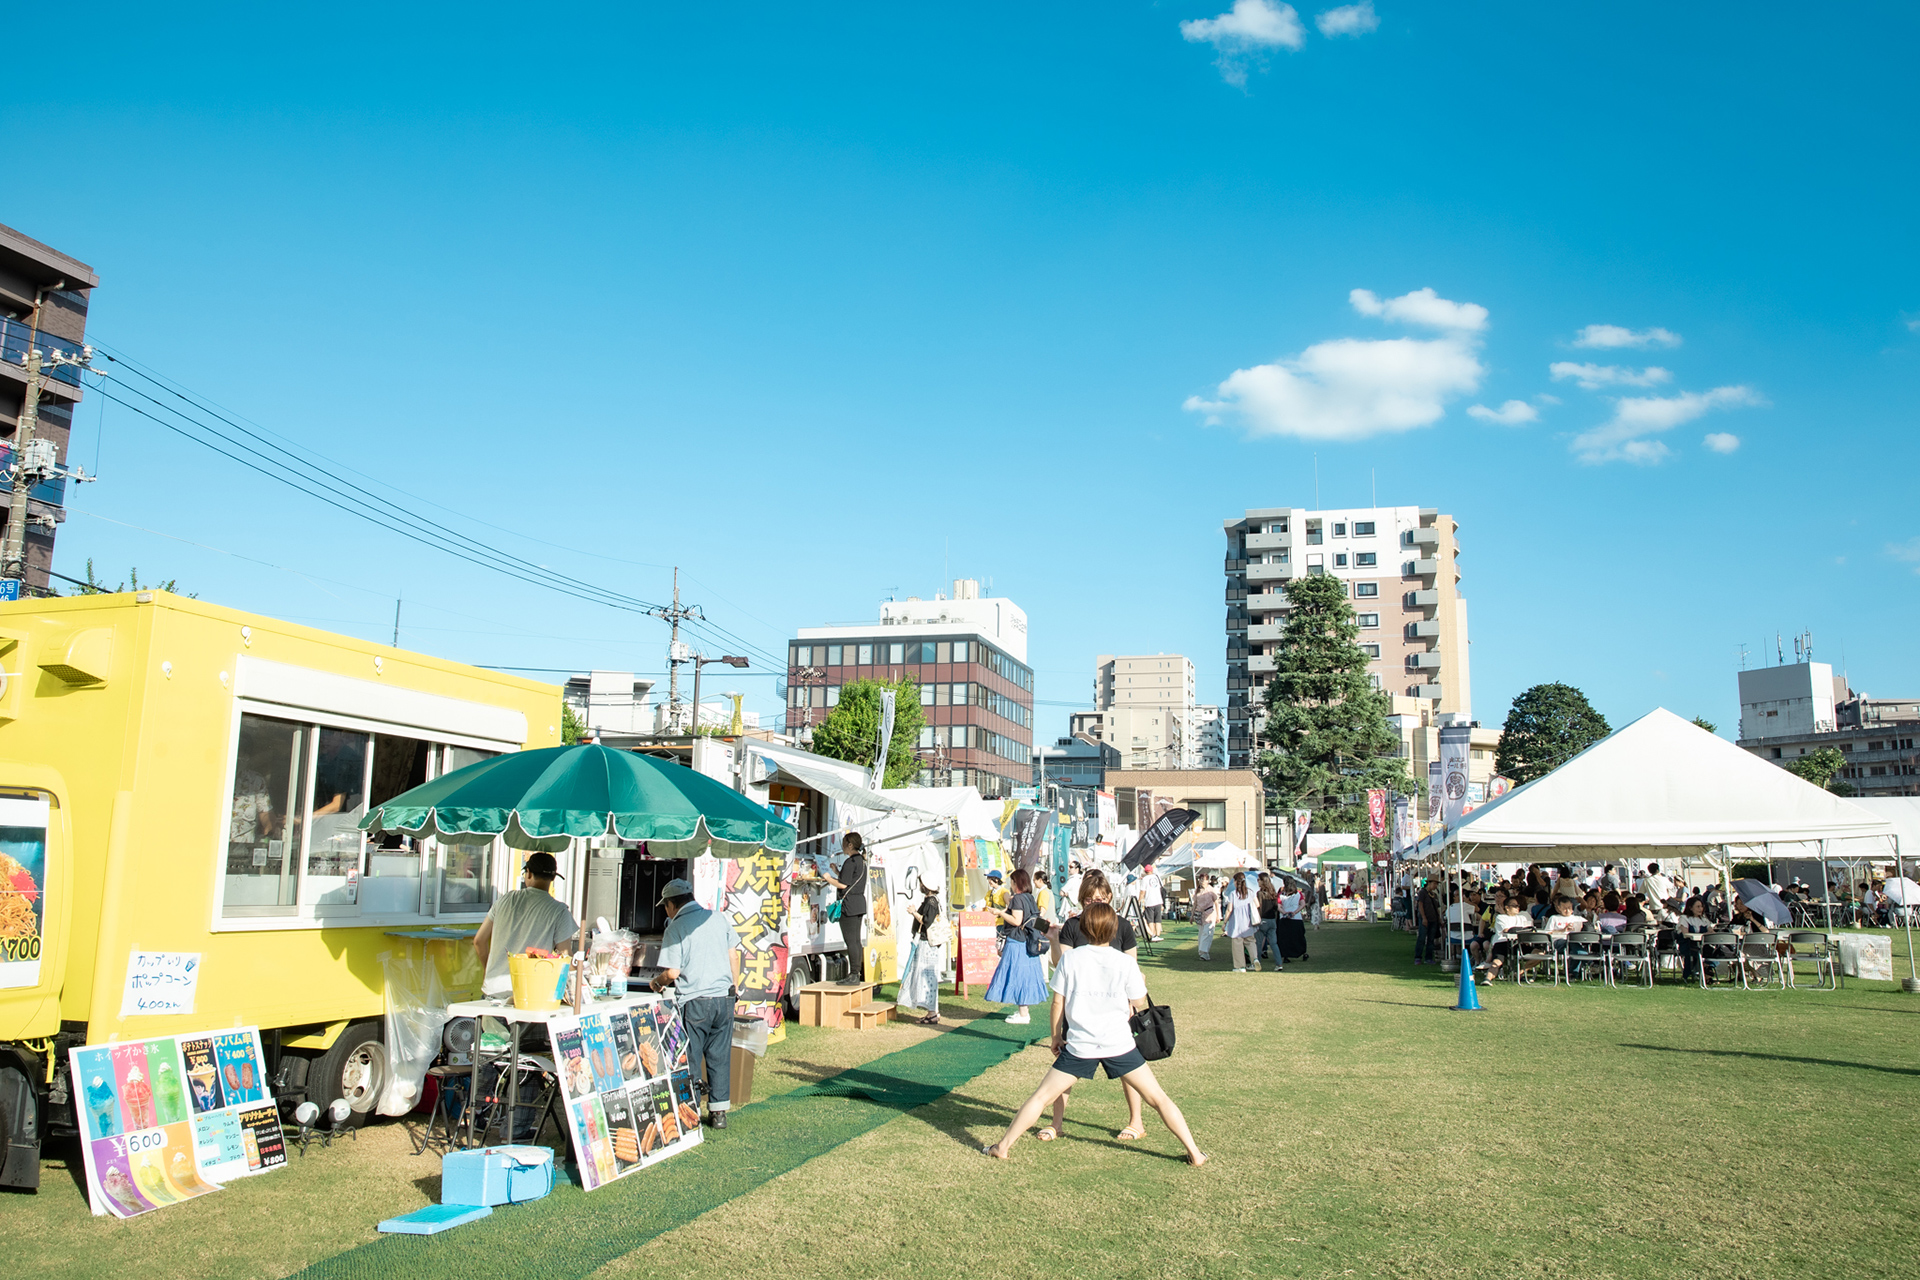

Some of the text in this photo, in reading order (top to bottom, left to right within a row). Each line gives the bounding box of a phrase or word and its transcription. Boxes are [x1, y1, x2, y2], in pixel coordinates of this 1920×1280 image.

[733, 847, 785, 991] 焼きそば
[132, 972, 192, 988] ポップコーン
[182, 1039, 212, 1053] ポテトスナック
[214, 1033, 253, 1048] スパム串
[95, 1044, 160, 1062] ホイップかき氷
[224, 1049, 245, 1060] ¥400
[263, 1154, 285, 1166] ¥800
